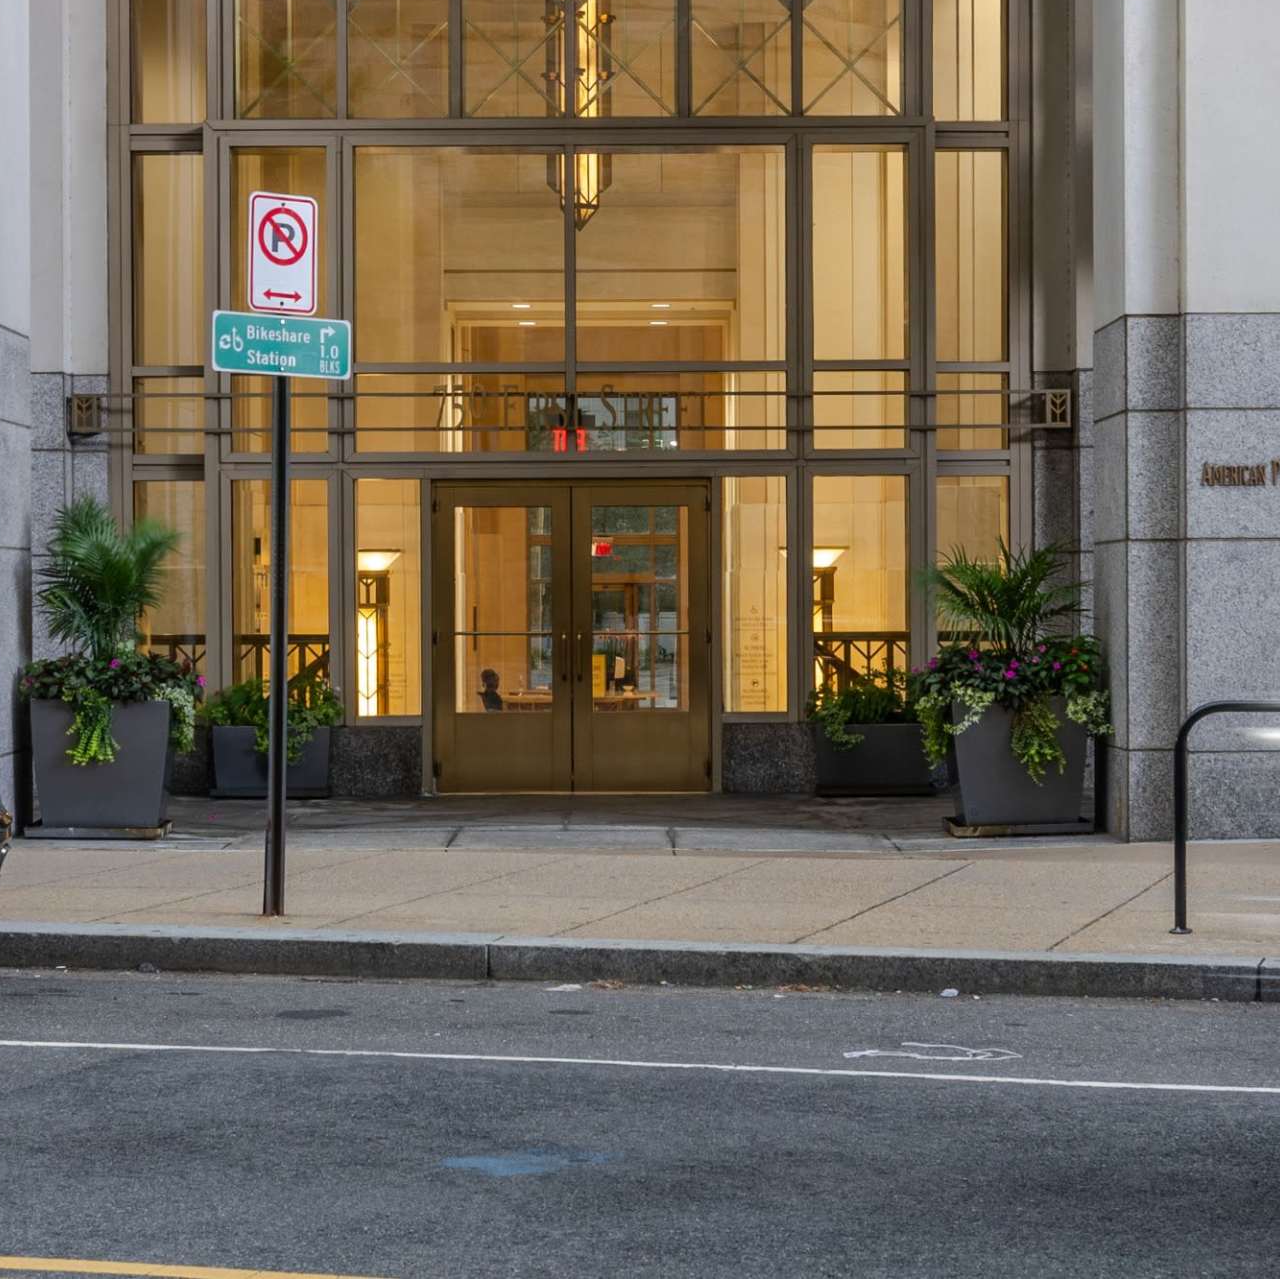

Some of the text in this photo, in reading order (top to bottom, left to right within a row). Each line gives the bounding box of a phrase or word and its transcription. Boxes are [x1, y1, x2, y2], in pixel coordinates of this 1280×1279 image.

[246, 325, 311, 344] Bikeshare
[246, 349, 297, 367] Station
[320, 345, 339, 359] 1.0
[320, 361, 341, 375] BLKS
[1200, 461, 1266, 487] AMERICAN
